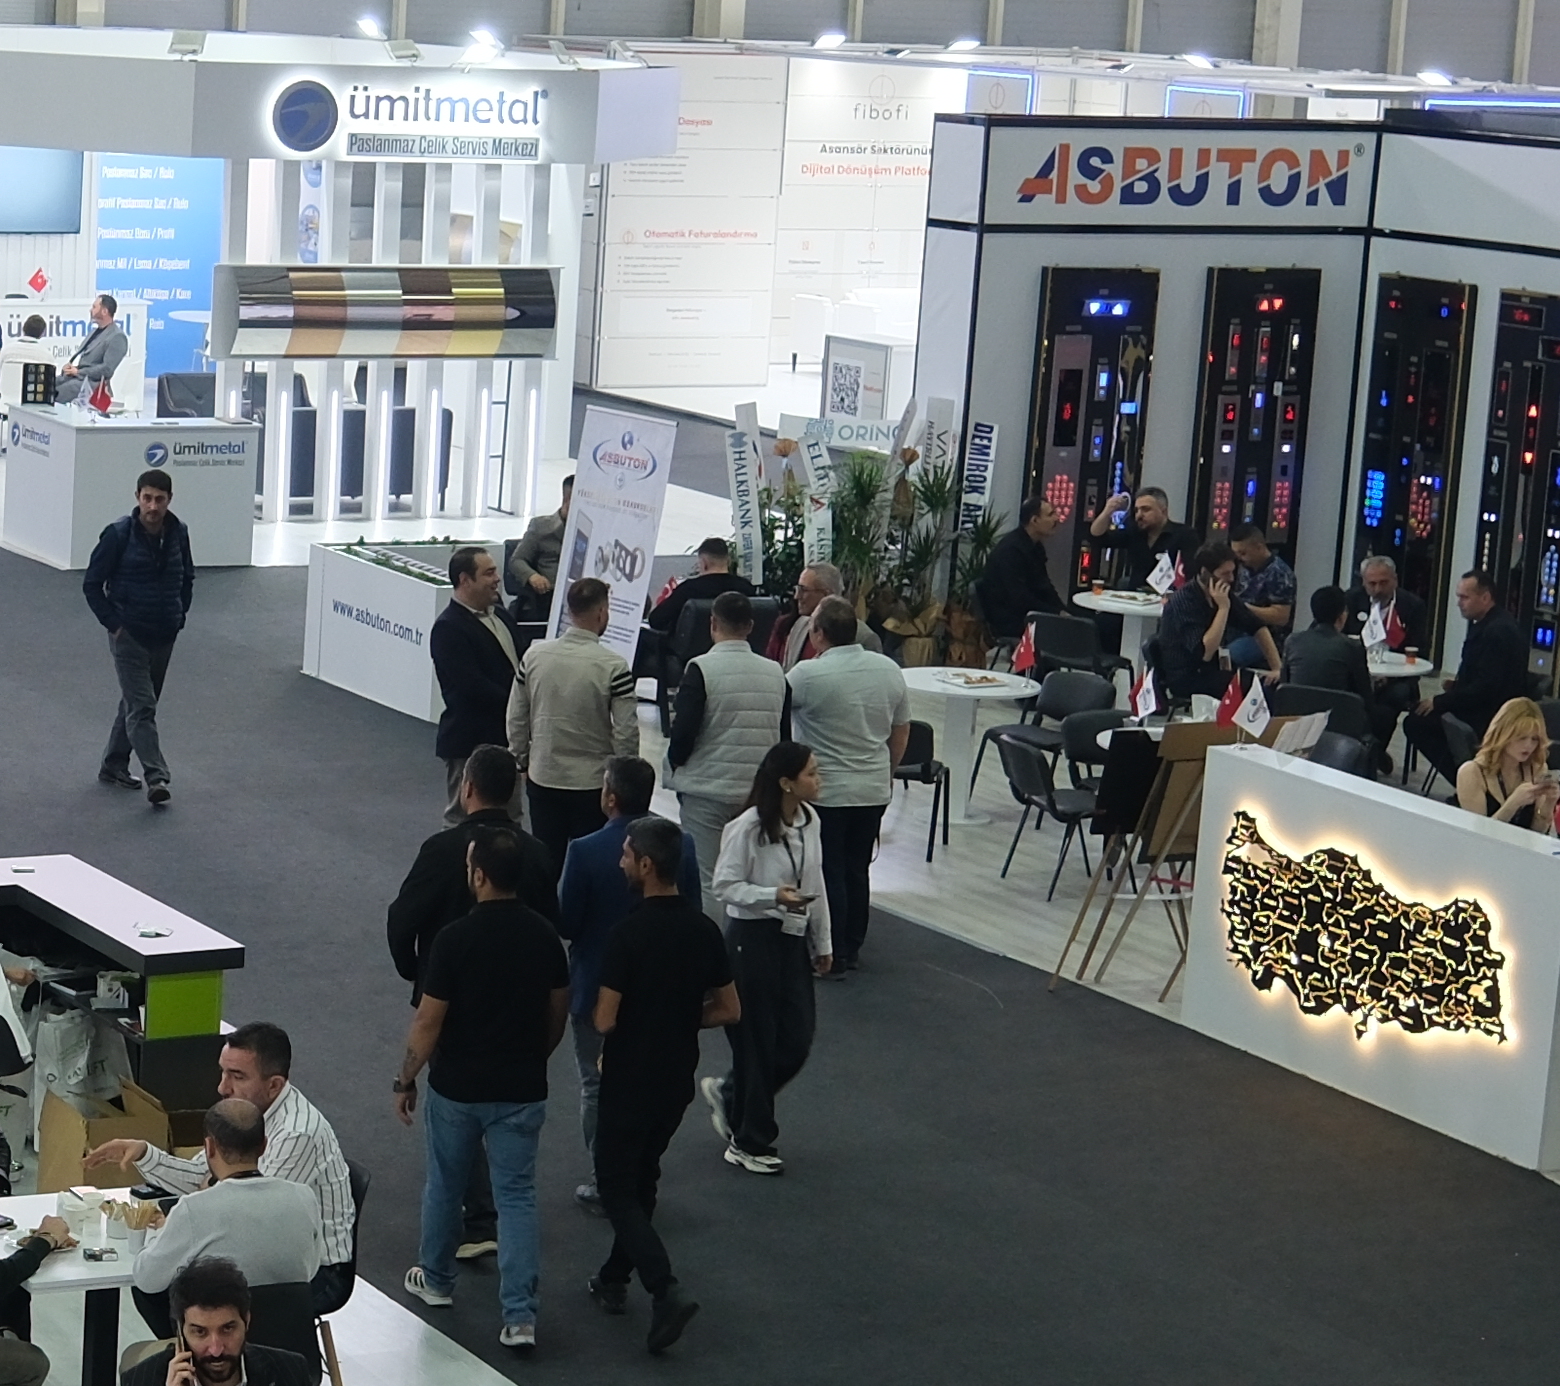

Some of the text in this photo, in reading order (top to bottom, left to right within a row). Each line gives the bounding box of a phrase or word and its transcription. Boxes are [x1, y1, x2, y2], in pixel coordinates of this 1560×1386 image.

[349, 85, 540, 126] ümitmetal
[853, 102, 910, 121] fibofi
[349, 133, 539, 158] Paslanmaz Çelik Servis Merkezi
[819, 143, 867, 156] Asansör
[837, 163, 892, 179] Dönüşüm
[1016, 142, 1350, 207] ASBUTON
[598, 452, 650, 471] ASBUTON
[963, 420, 995, 501] DEMİROK
[732, 448, 754, 530] HALKBANK
[331, 596, 425, 649] www.asbuton.com.tr
